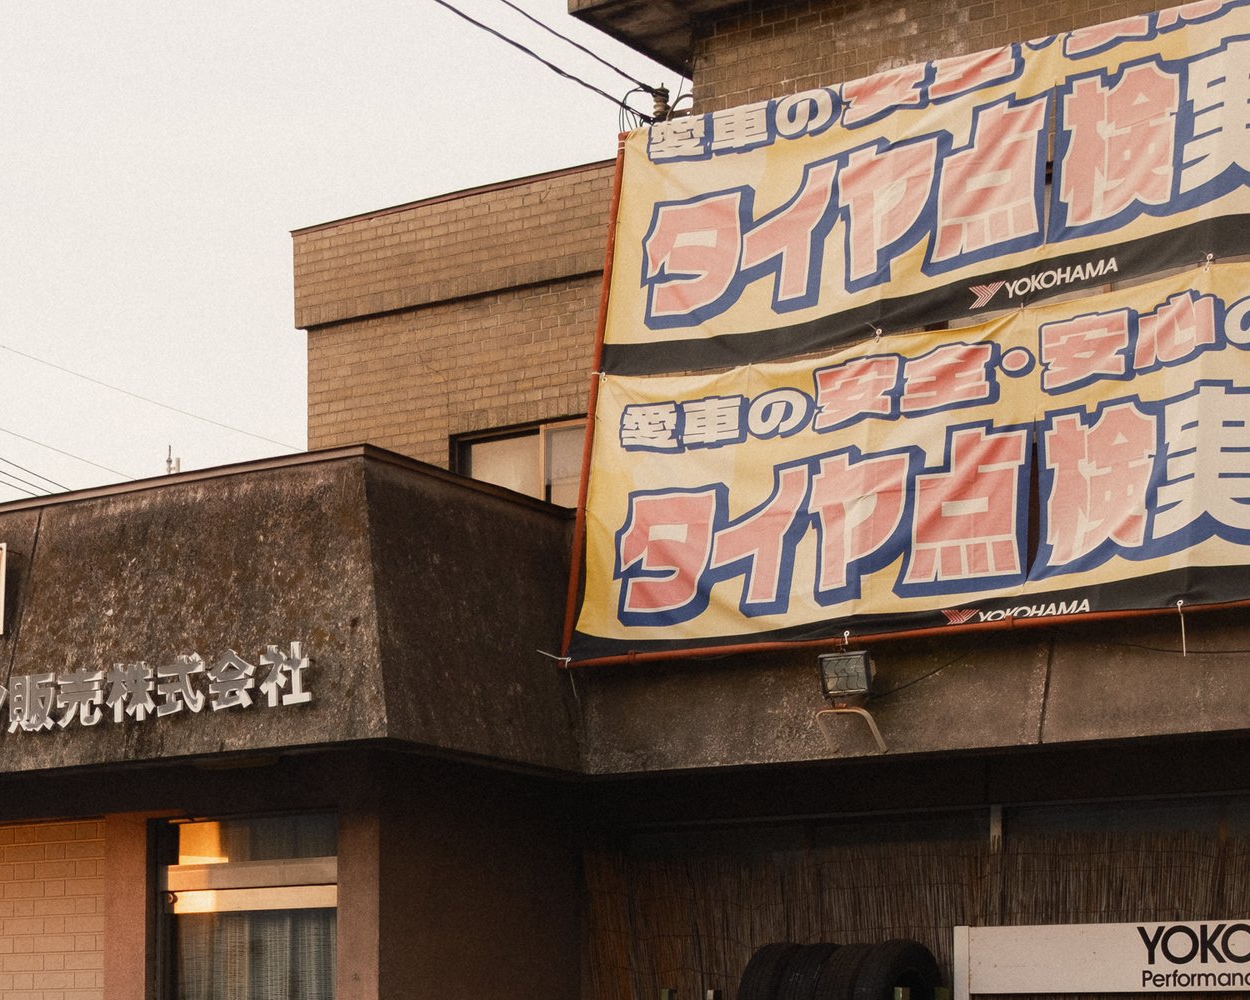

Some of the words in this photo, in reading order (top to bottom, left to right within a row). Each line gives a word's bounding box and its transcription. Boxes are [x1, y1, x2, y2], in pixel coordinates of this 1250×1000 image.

[1005, 257, 1118, 298] YOKOHAMA
[618, 384, 1250, 615] タイヤ点検実
